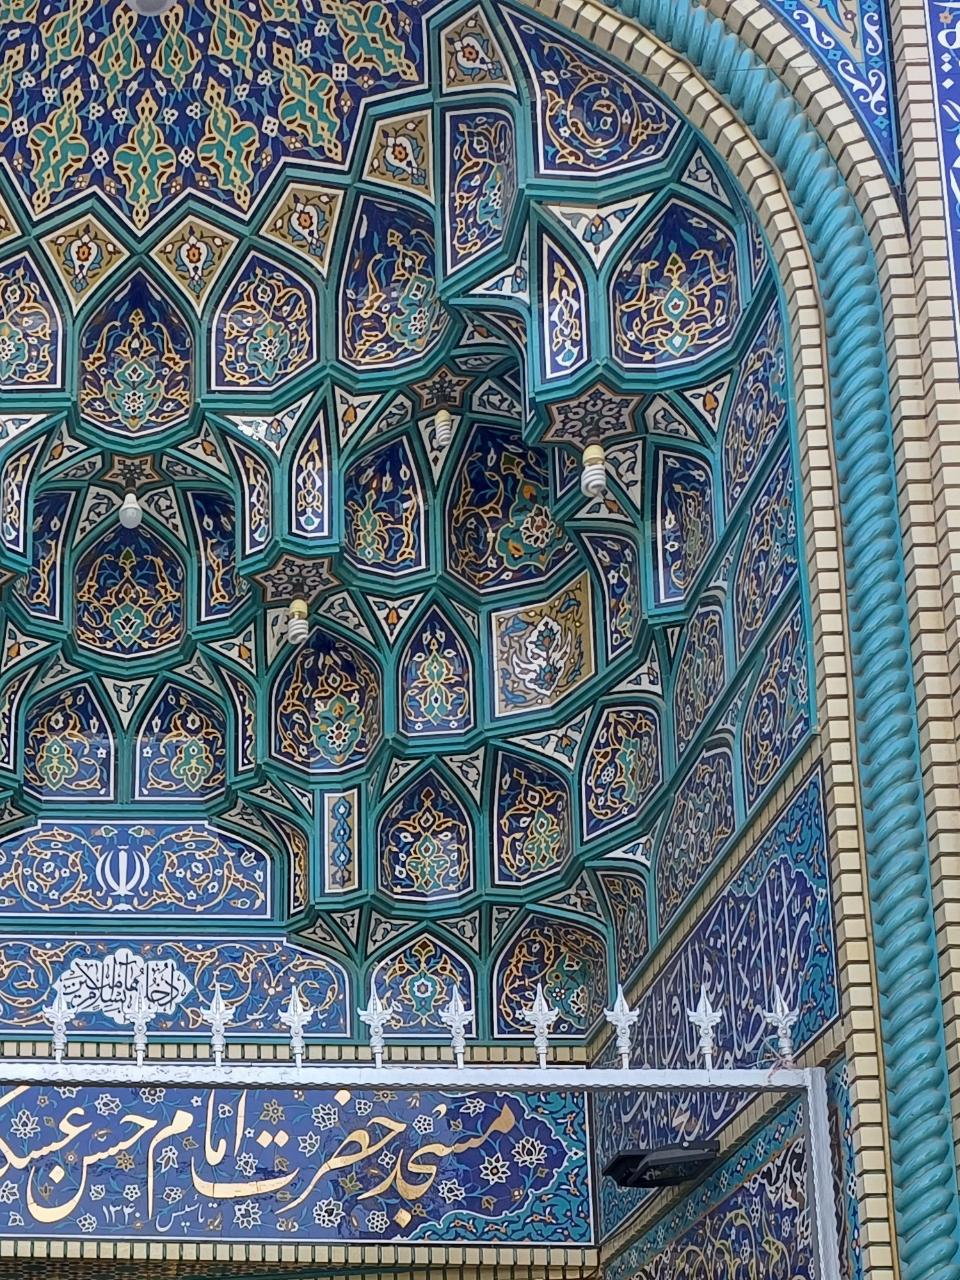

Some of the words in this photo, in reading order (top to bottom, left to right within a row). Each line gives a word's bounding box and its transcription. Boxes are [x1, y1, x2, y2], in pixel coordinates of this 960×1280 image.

[25, 1114, 158, 1223] حسن
[101, 1202, 141, 1226] ۱۳۴۰
[146, 1089, 248, 1221] امام
[191, 1089, 407, 1215] حضرت
[355, 1101, 516, 1228] مسجد
